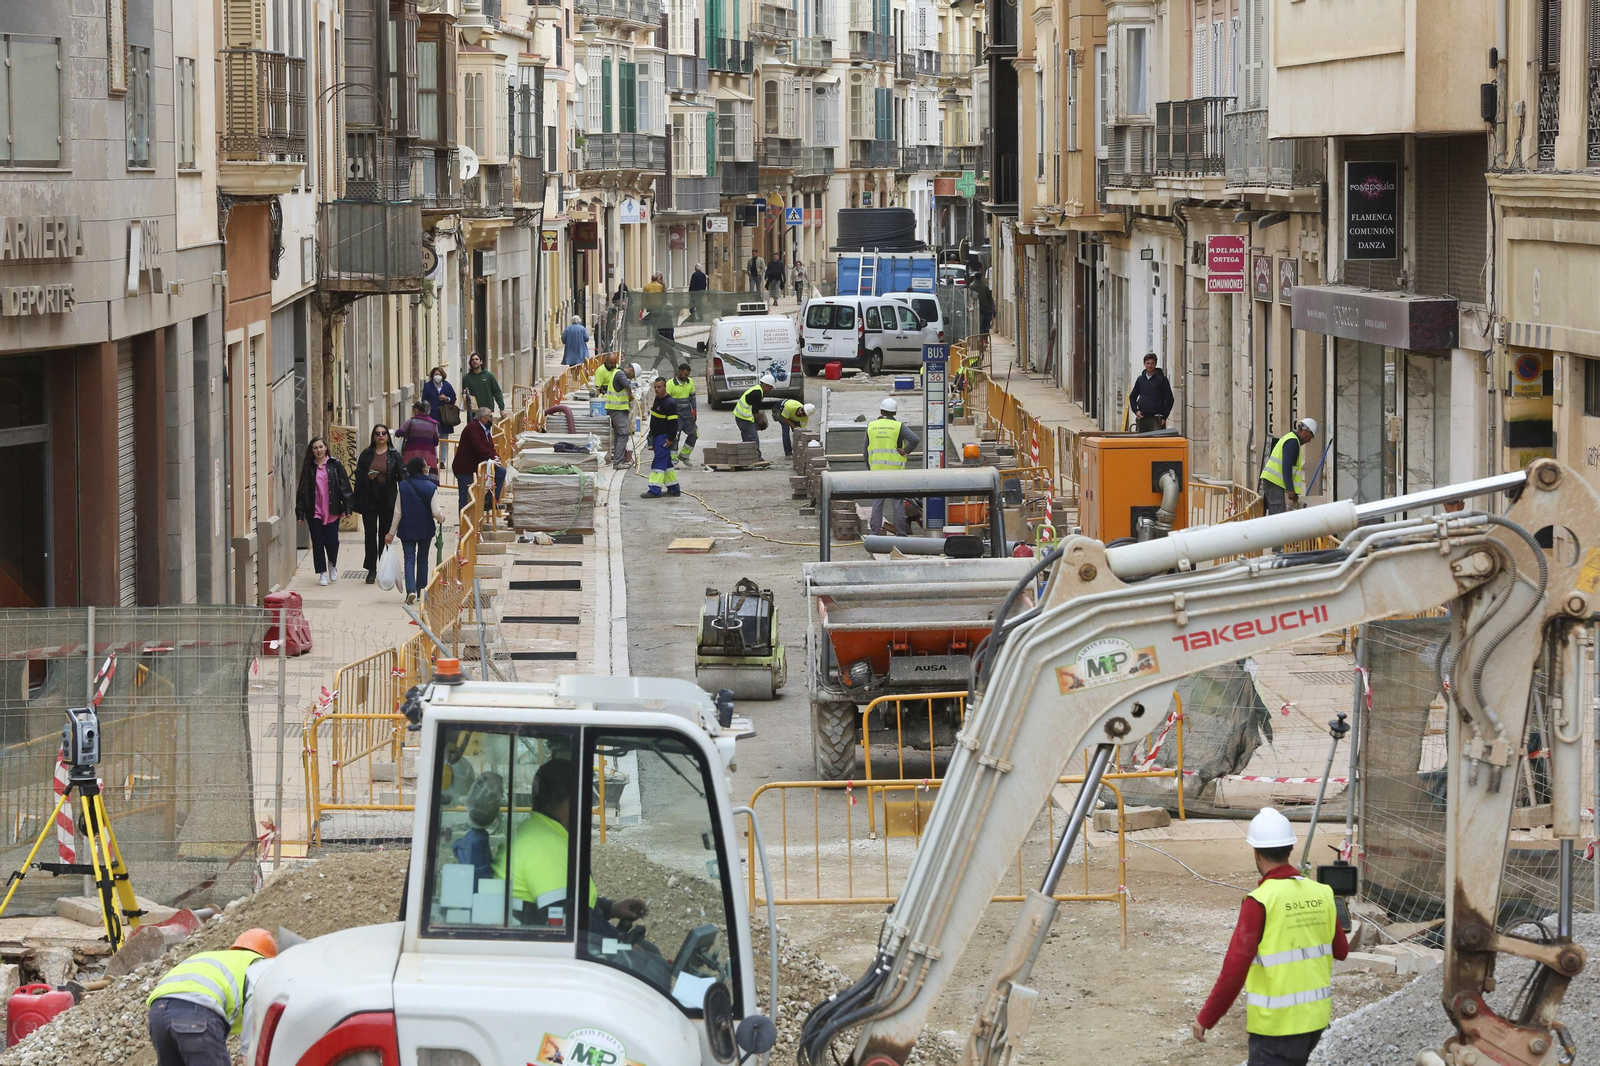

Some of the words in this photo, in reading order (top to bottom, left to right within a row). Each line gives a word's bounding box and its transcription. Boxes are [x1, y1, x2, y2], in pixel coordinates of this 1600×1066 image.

[1351, 213, 1393, 221] FLAMENCA
[1349, 225, 1395, 235] COMUNIÓN
[2, 215, 85, 259] ARMERIA
[1358, 241, 1386, 249] DANZA
[1208, 278, 1243, 289] COMUNIONES
[7, 284, 77, 316] DEPORTES
[927, 347, 944, 359] BUS
[930, 372, 941, 382] 36
[914, 664, 947, 672] AUSA
